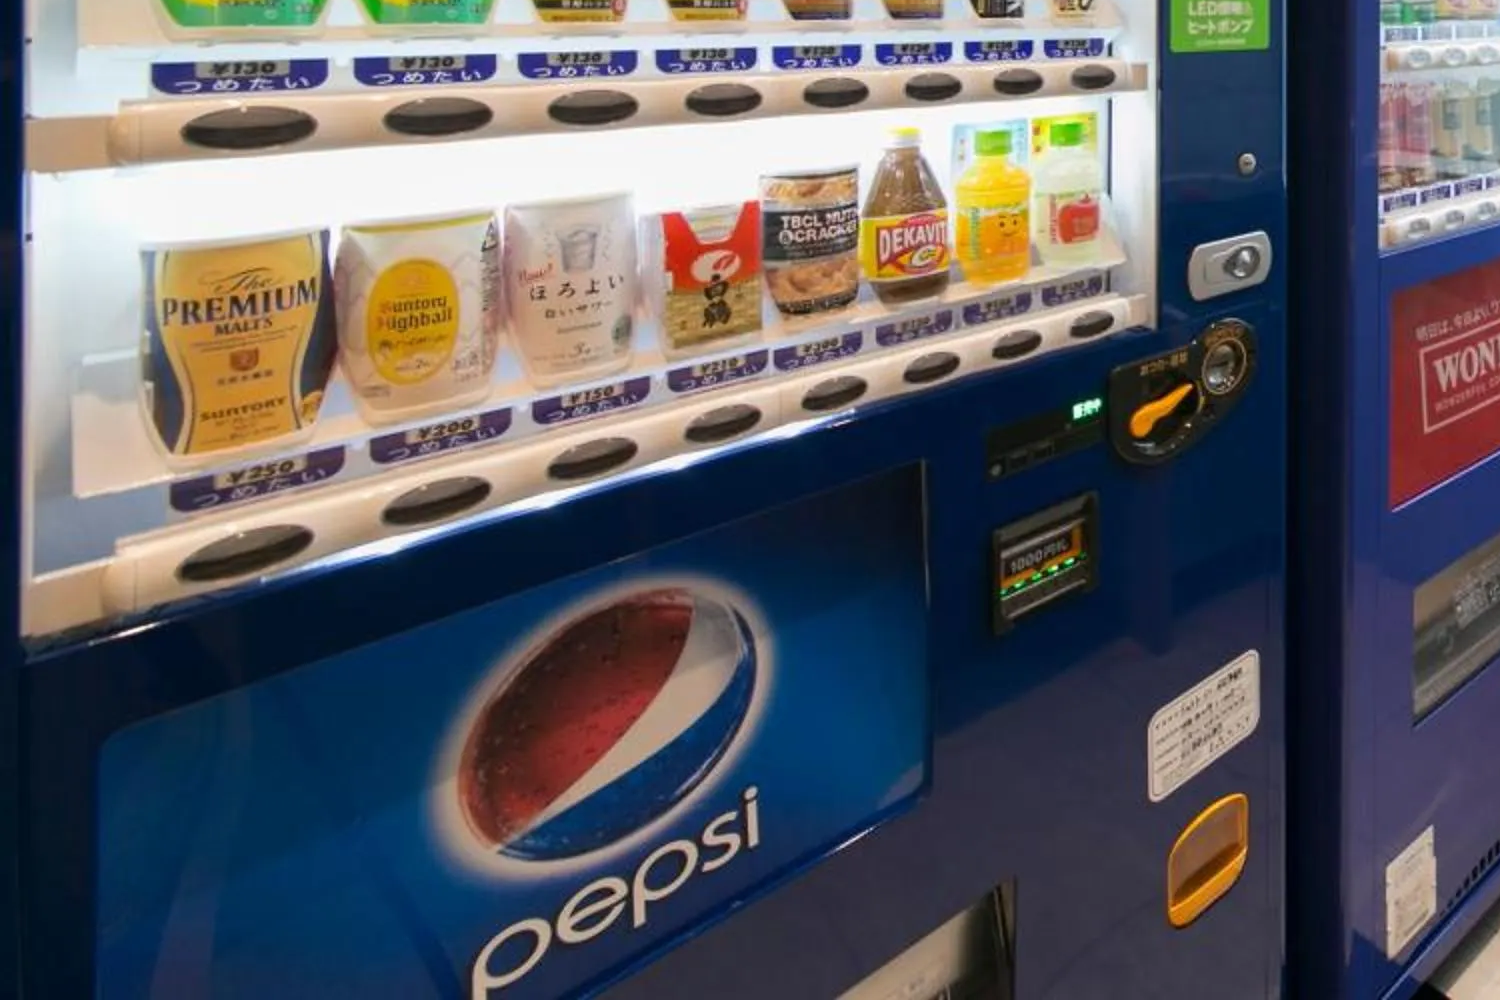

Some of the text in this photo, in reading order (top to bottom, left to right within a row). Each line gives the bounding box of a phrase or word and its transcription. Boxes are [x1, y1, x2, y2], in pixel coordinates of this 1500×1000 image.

[208, 61, 276, 77] ¥130
[399, 56, 455, 70] ¥130
[533, 65, 625, 79] つめたい
[668, 60, 748, 73] つめたい
[174, 76, 309, 94] つめたい
[371, 69, 483, 85] つめたい
[529, 275, 625, 302] ほろよい
[162, 276, 319, 327] PREMIUM
[568, 384, 616, 407] ¥150
[200, 396, 288, 422] SUNTORY
[389, 426, 500, 460] つめたい
[418, 418, 475, 443] ¥200
[228, 459, 297, 487] ¥250
[191, 467, 328, 506] つめたい
[471, 786, 760, 1000] pepsi
